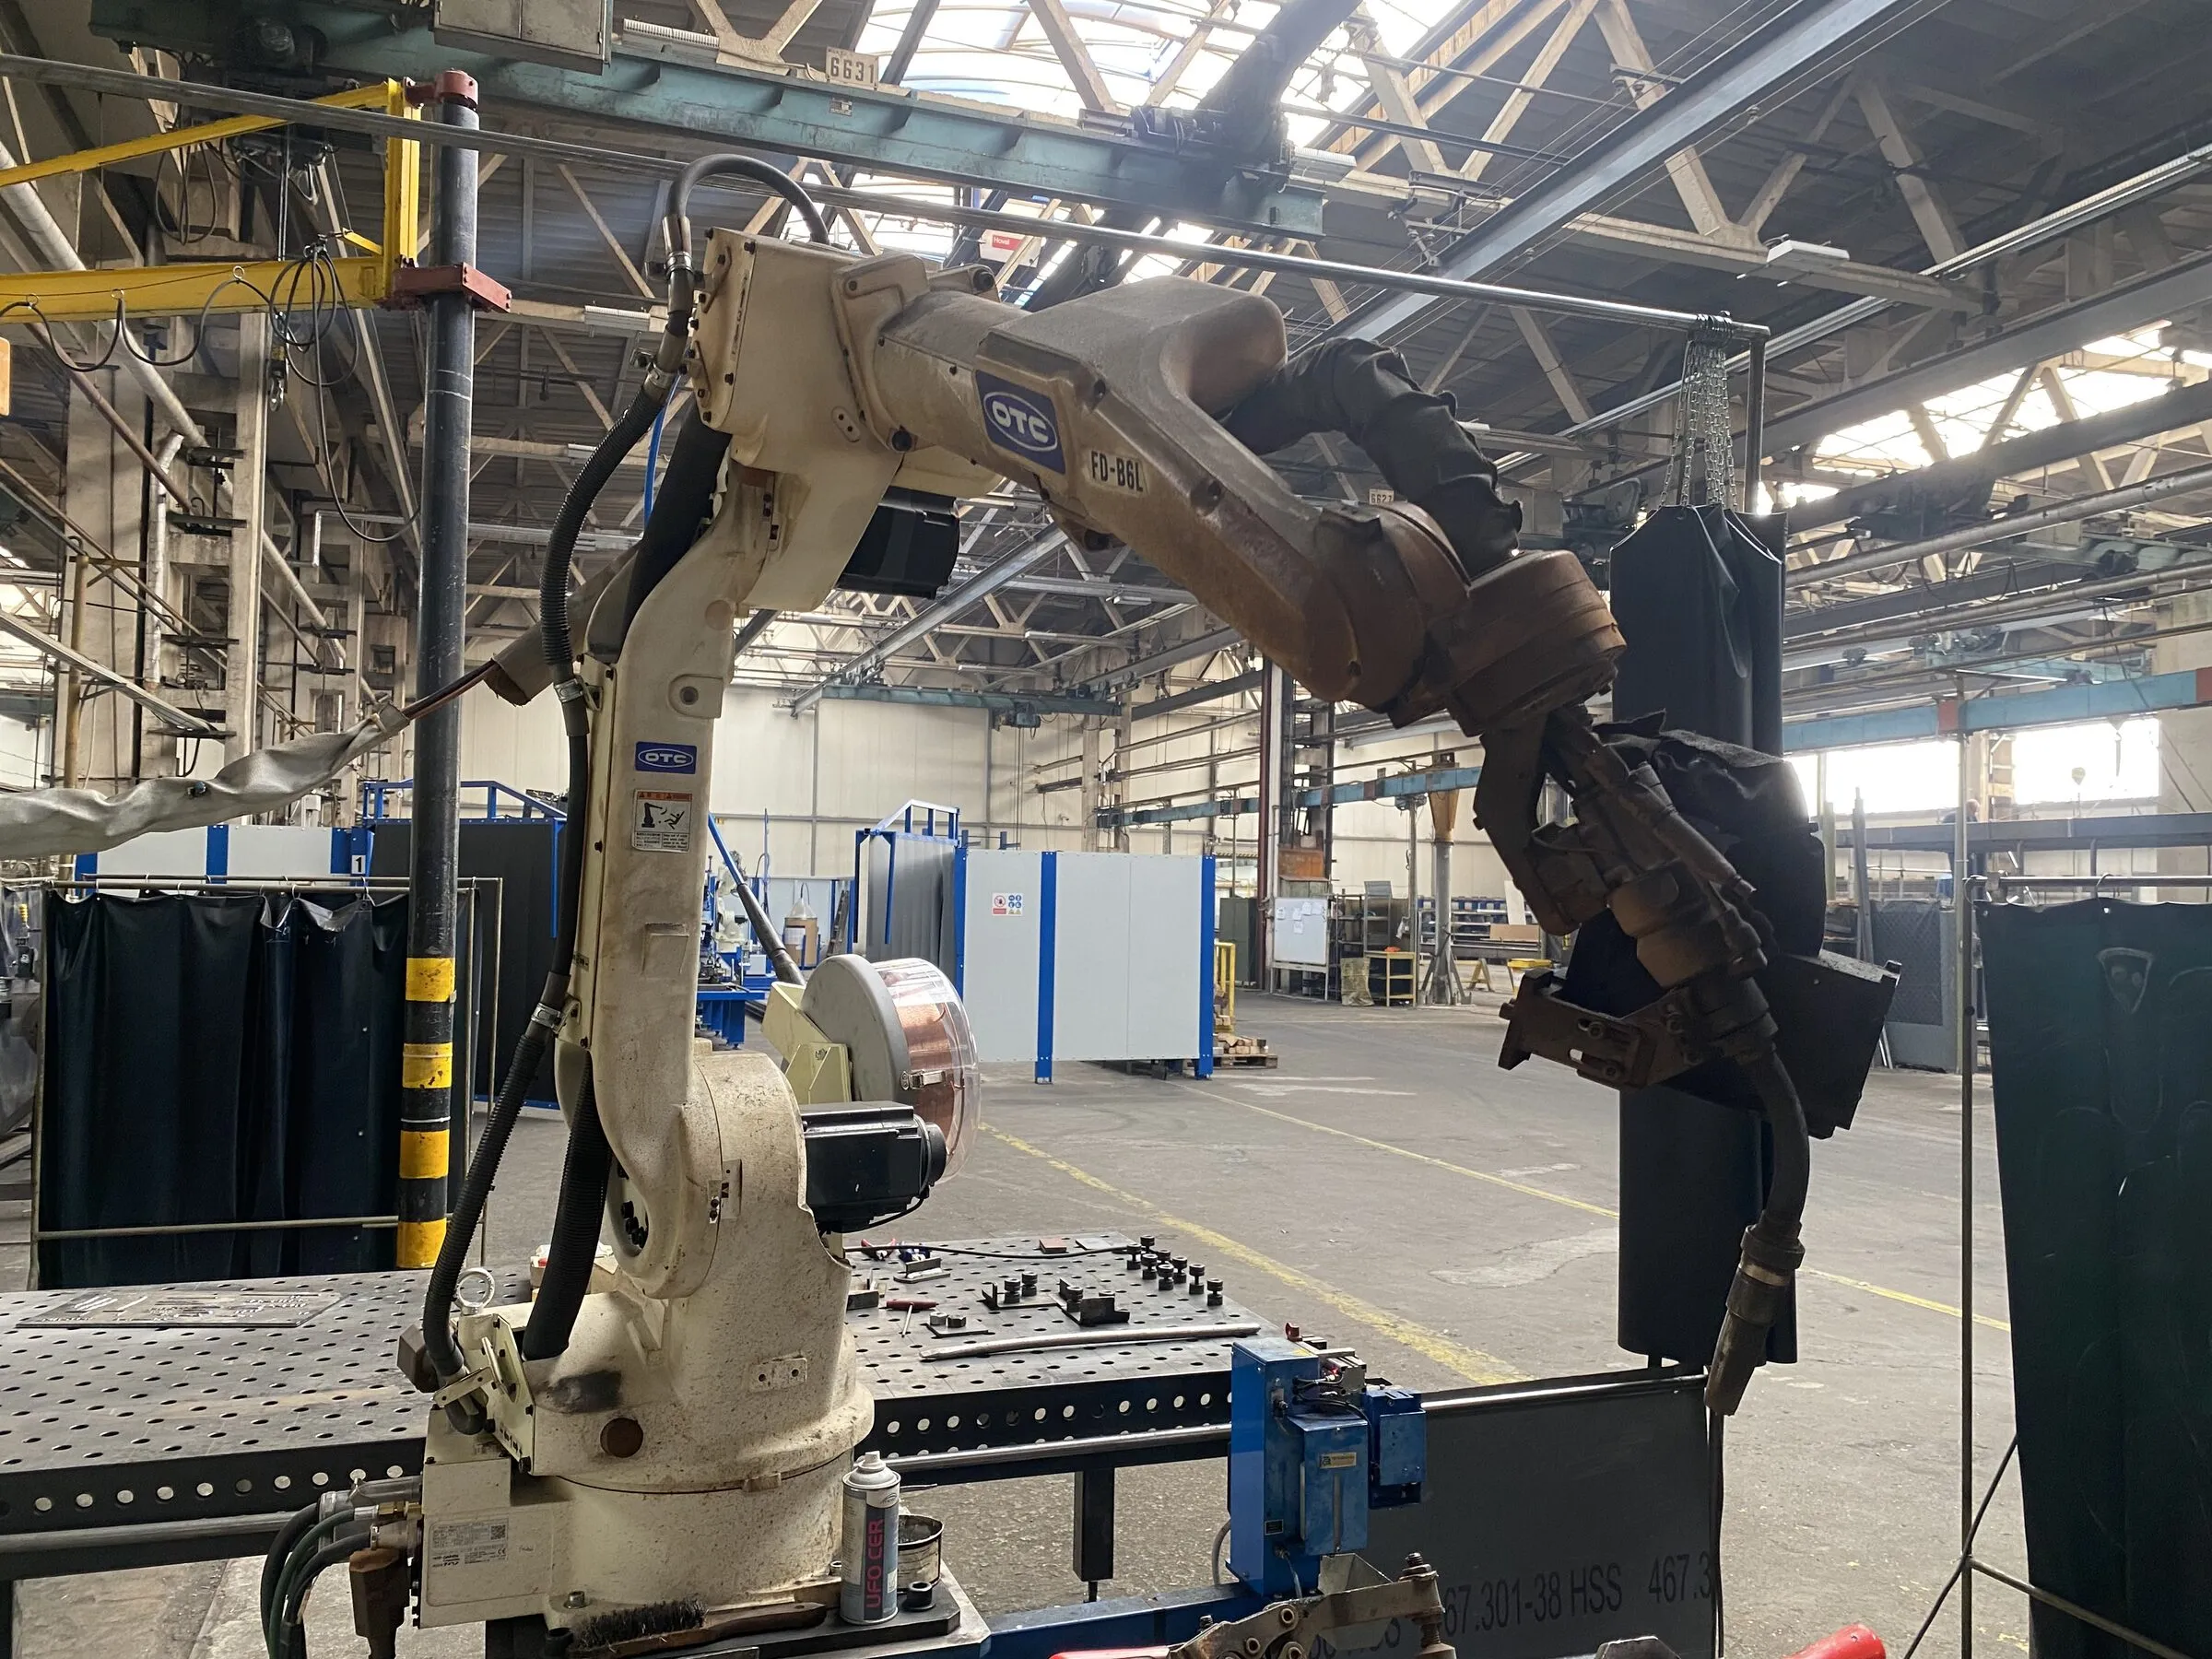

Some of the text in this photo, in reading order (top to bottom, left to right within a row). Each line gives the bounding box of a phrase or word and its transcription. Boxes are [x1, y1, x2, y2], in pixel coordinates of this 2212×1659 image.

[830, 56, 875, 84] 6631
[992, 400, 1049, 443] OTC
[1090, 450, 1144, 492] FD-B6L
[645, 752, 687, 764] OTC
[355, 856, 362, 873] 1
[865, 1518, 885, 1608] UFO CER
[1441, 1571, 1563, 1638] 67.301-38
[1570, 1562, 1623, 1618] HSS
